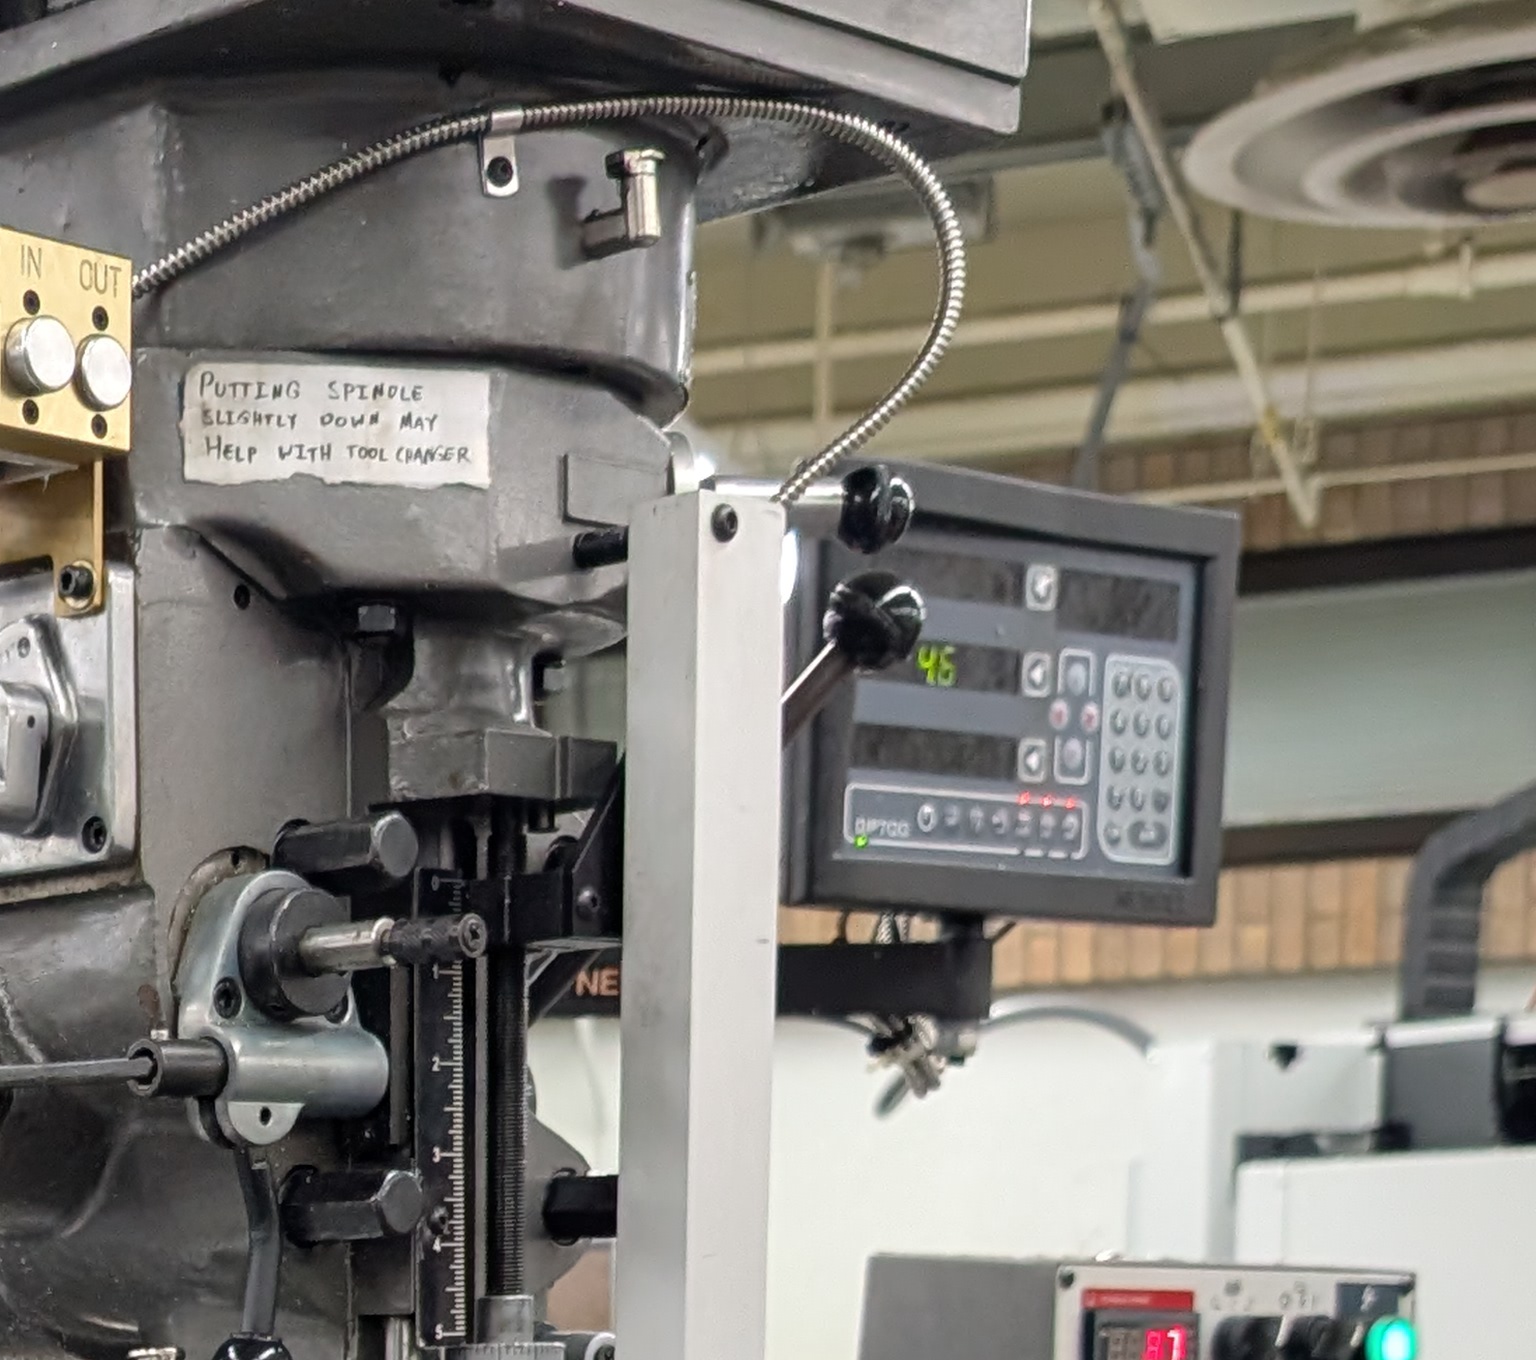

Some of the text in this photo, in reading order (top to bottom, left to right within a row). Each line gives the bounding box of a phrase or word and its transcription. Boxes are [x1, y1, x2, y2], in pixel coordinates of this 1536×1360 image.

[20, 244, 42, 279] IN
[79, 258, 122, 298] OUT
[199, 371, 424, 401] PUTTING SPINDLE
[201, 408, 438, 432] SLIGHTLY DOWN MAY
[205, 435, 472, 465] HELP WITH TOOL CHANGER
[431, 962, 440, 979] 1
[431, 1054, 441, 1072] 2
[431, 1146, 441, 1163] 3
[431, 1236, 442, 1254] 4
[434, 1323, 444, 1340] 5
